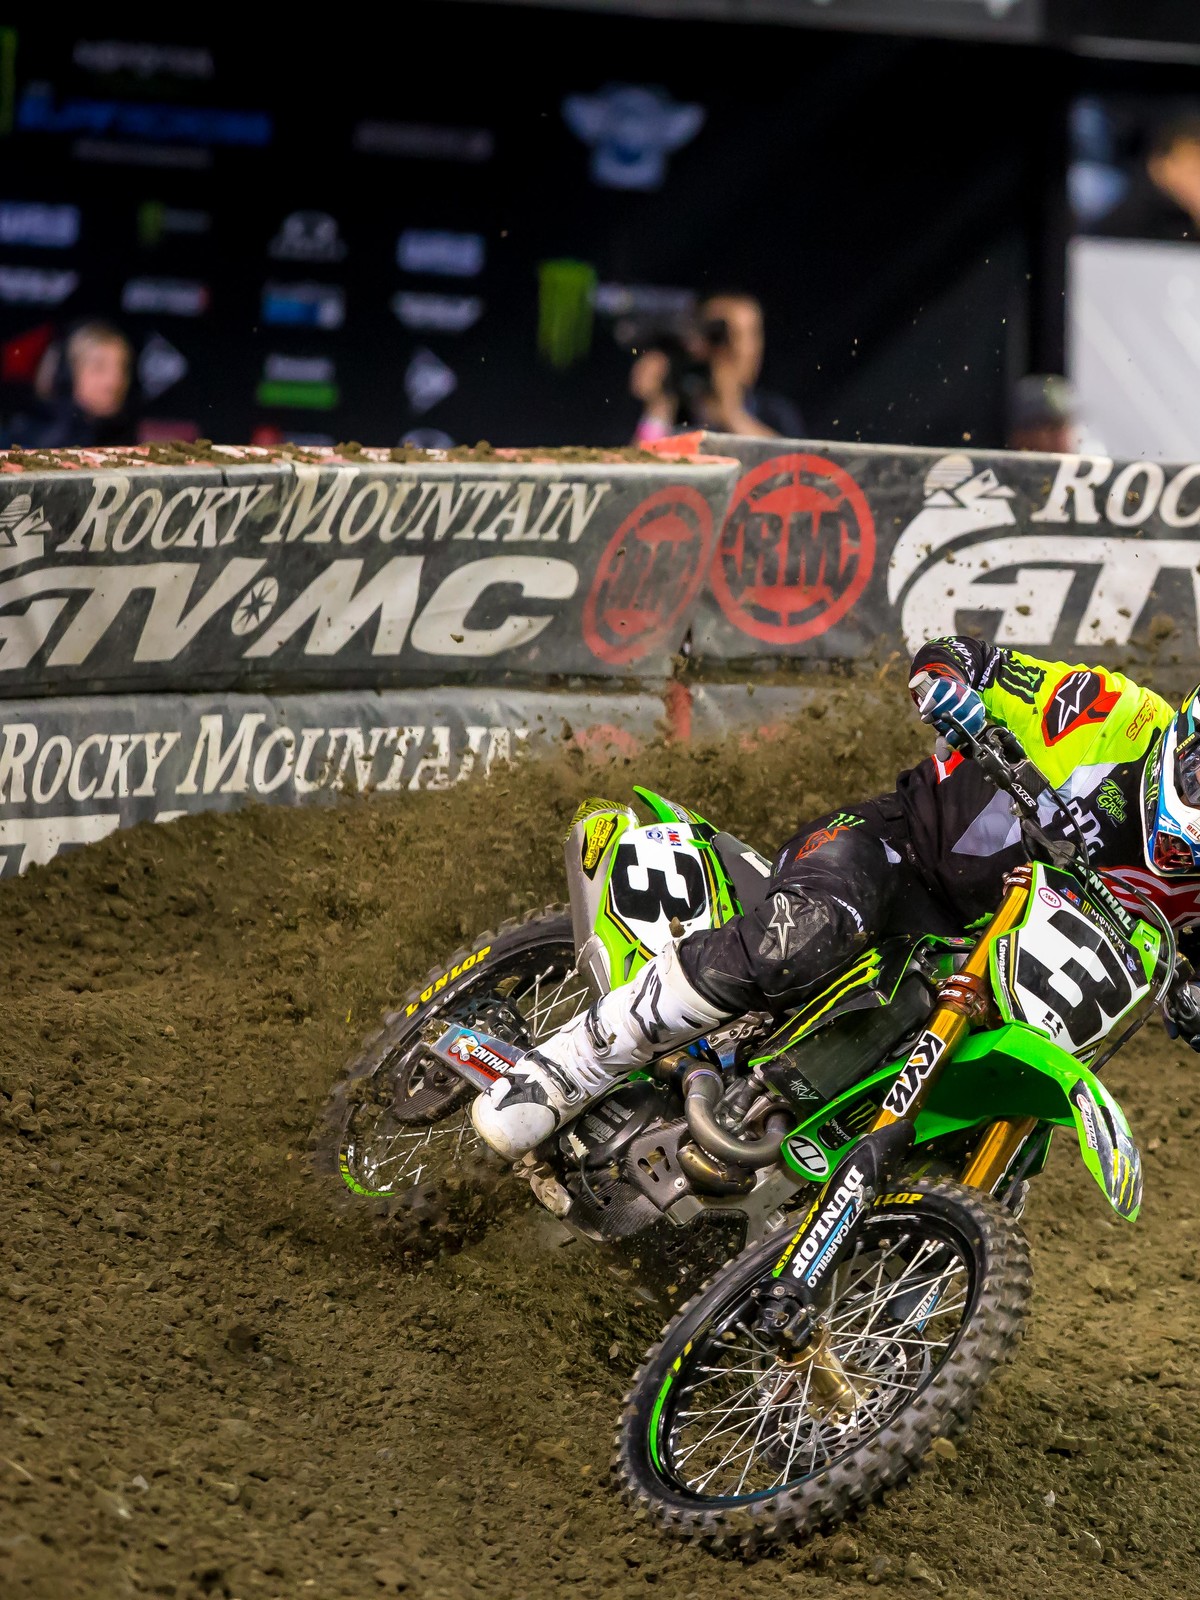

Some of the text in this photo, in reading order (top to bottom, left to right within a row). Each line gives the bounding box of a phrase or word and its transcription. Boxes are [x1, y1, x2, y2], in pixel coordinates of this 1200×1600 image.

[56, 466, 611, 554] ROCKY MOUNTAIN
[0, 712, 532, 805] ROCKY MOUNTAIN
[1101, 778, 1125, 808] TEAM
[1097, 793, 1126, 823] GREEN
[611, 843, 708, 924] 3
[1091, 909, 1126, 954] MONSTER
[1016, 908, 1133, 1048] 3
[792, 1164, 864, 1280] DUNLOP
[806, 1226, 848, 1288] CARRILLO
